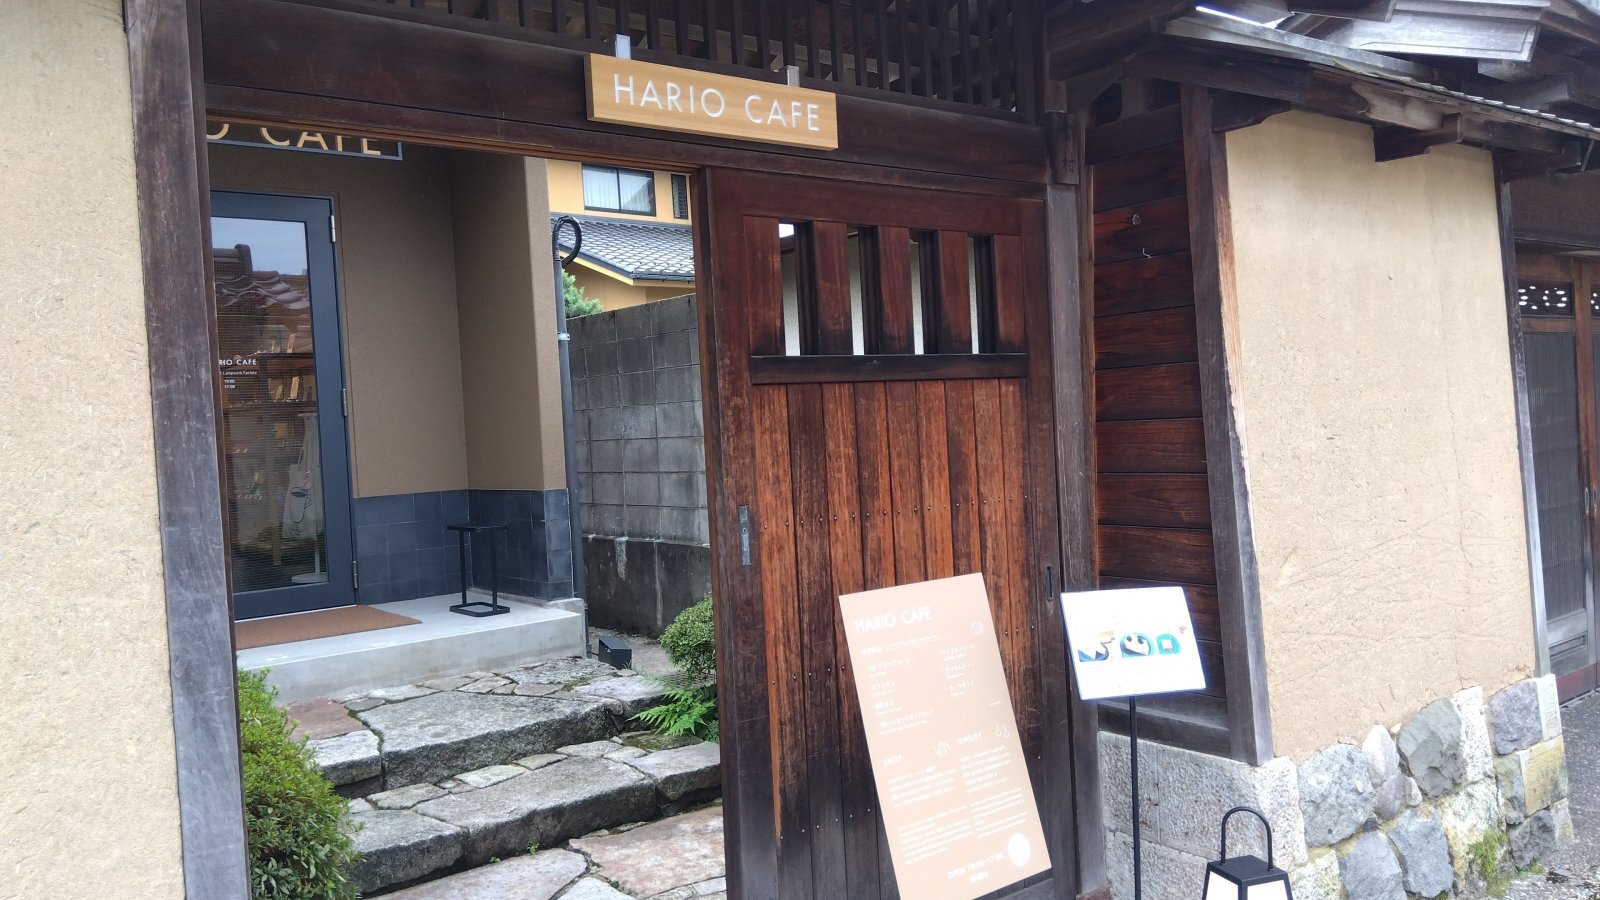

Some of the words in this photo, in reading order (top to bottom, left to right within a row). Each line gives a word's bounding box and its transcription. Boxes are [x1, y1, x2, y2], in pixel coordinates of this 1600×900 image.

[614, 73, 725, 118] HARIO
[745, 95, 819, 131] CAFE
[854, 613, 896, 634] HARIO
[902, 606, 932, 624] CAFE
